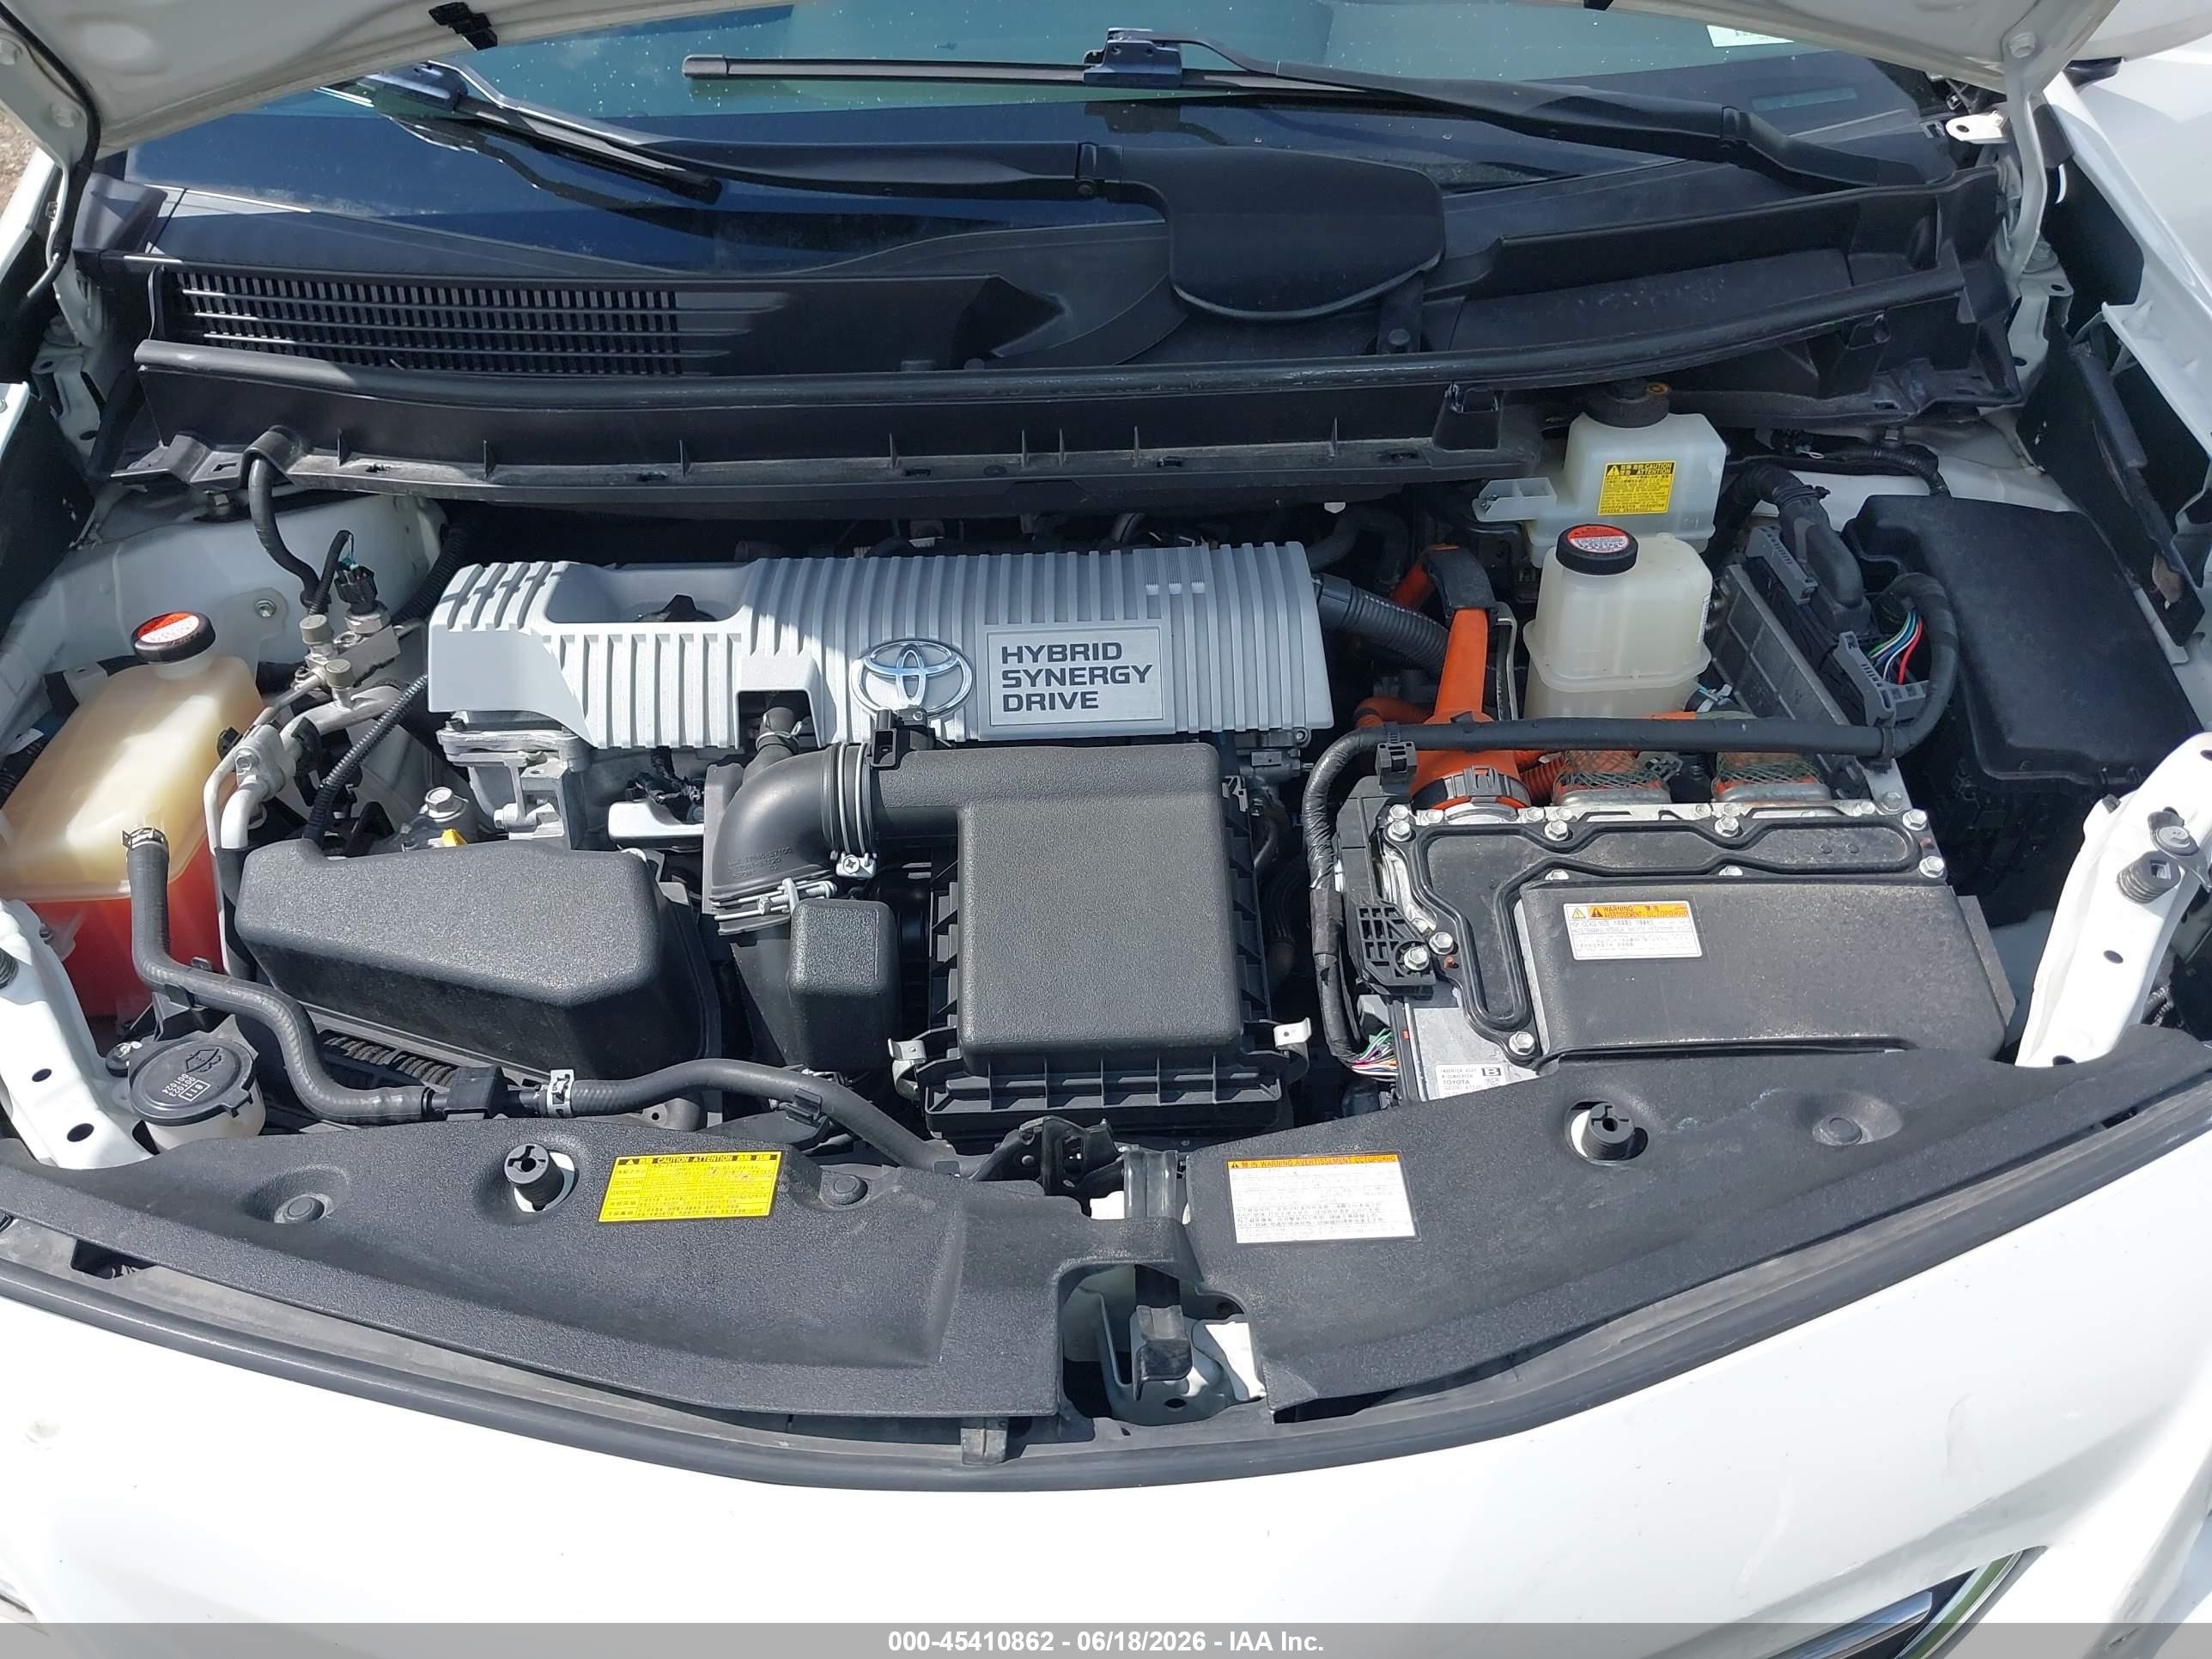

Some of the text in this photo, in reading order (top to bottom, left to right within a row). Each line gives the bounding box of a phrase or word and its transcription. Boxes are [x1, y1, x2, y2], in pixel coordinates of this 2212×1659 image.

[1001, 642, 1122, 665] HYBRID
[1002, 665, 1154, 689] SYNERGY
[1003, 690, 1099, 713] DRIVE
[1296, 1158, 1352, 1167] AVERTISSEMENT
